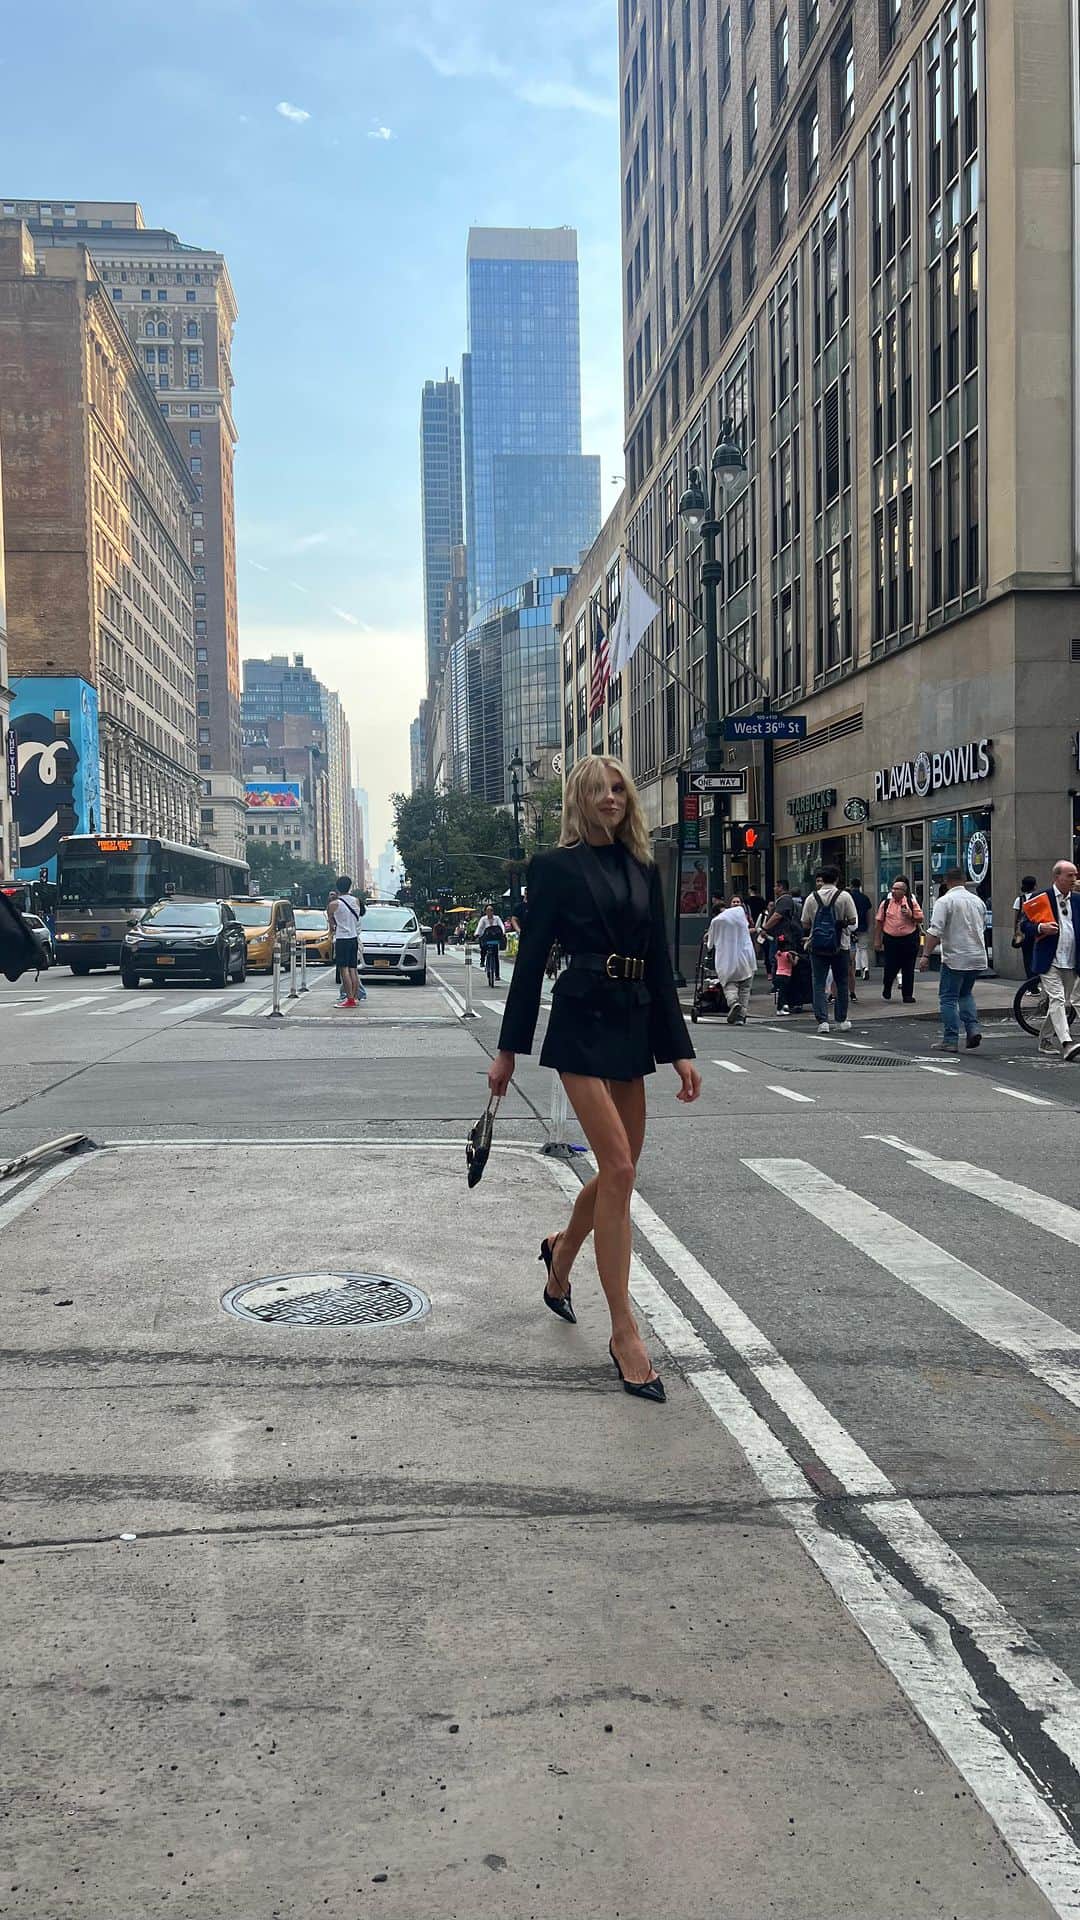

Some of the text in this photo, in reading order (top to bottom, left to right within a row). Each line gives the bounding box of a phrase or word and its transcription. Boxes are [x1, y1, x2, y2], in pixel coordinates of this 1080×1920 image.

[734, 721, 800, 734] West 36th St
[874, 762, 913, 802] PLAYA
[932, 739, 990, 789] BOWLS
[698, 778, 737, 787] ONE WAY
[785, 790, 835, 816] STARBUCKS
